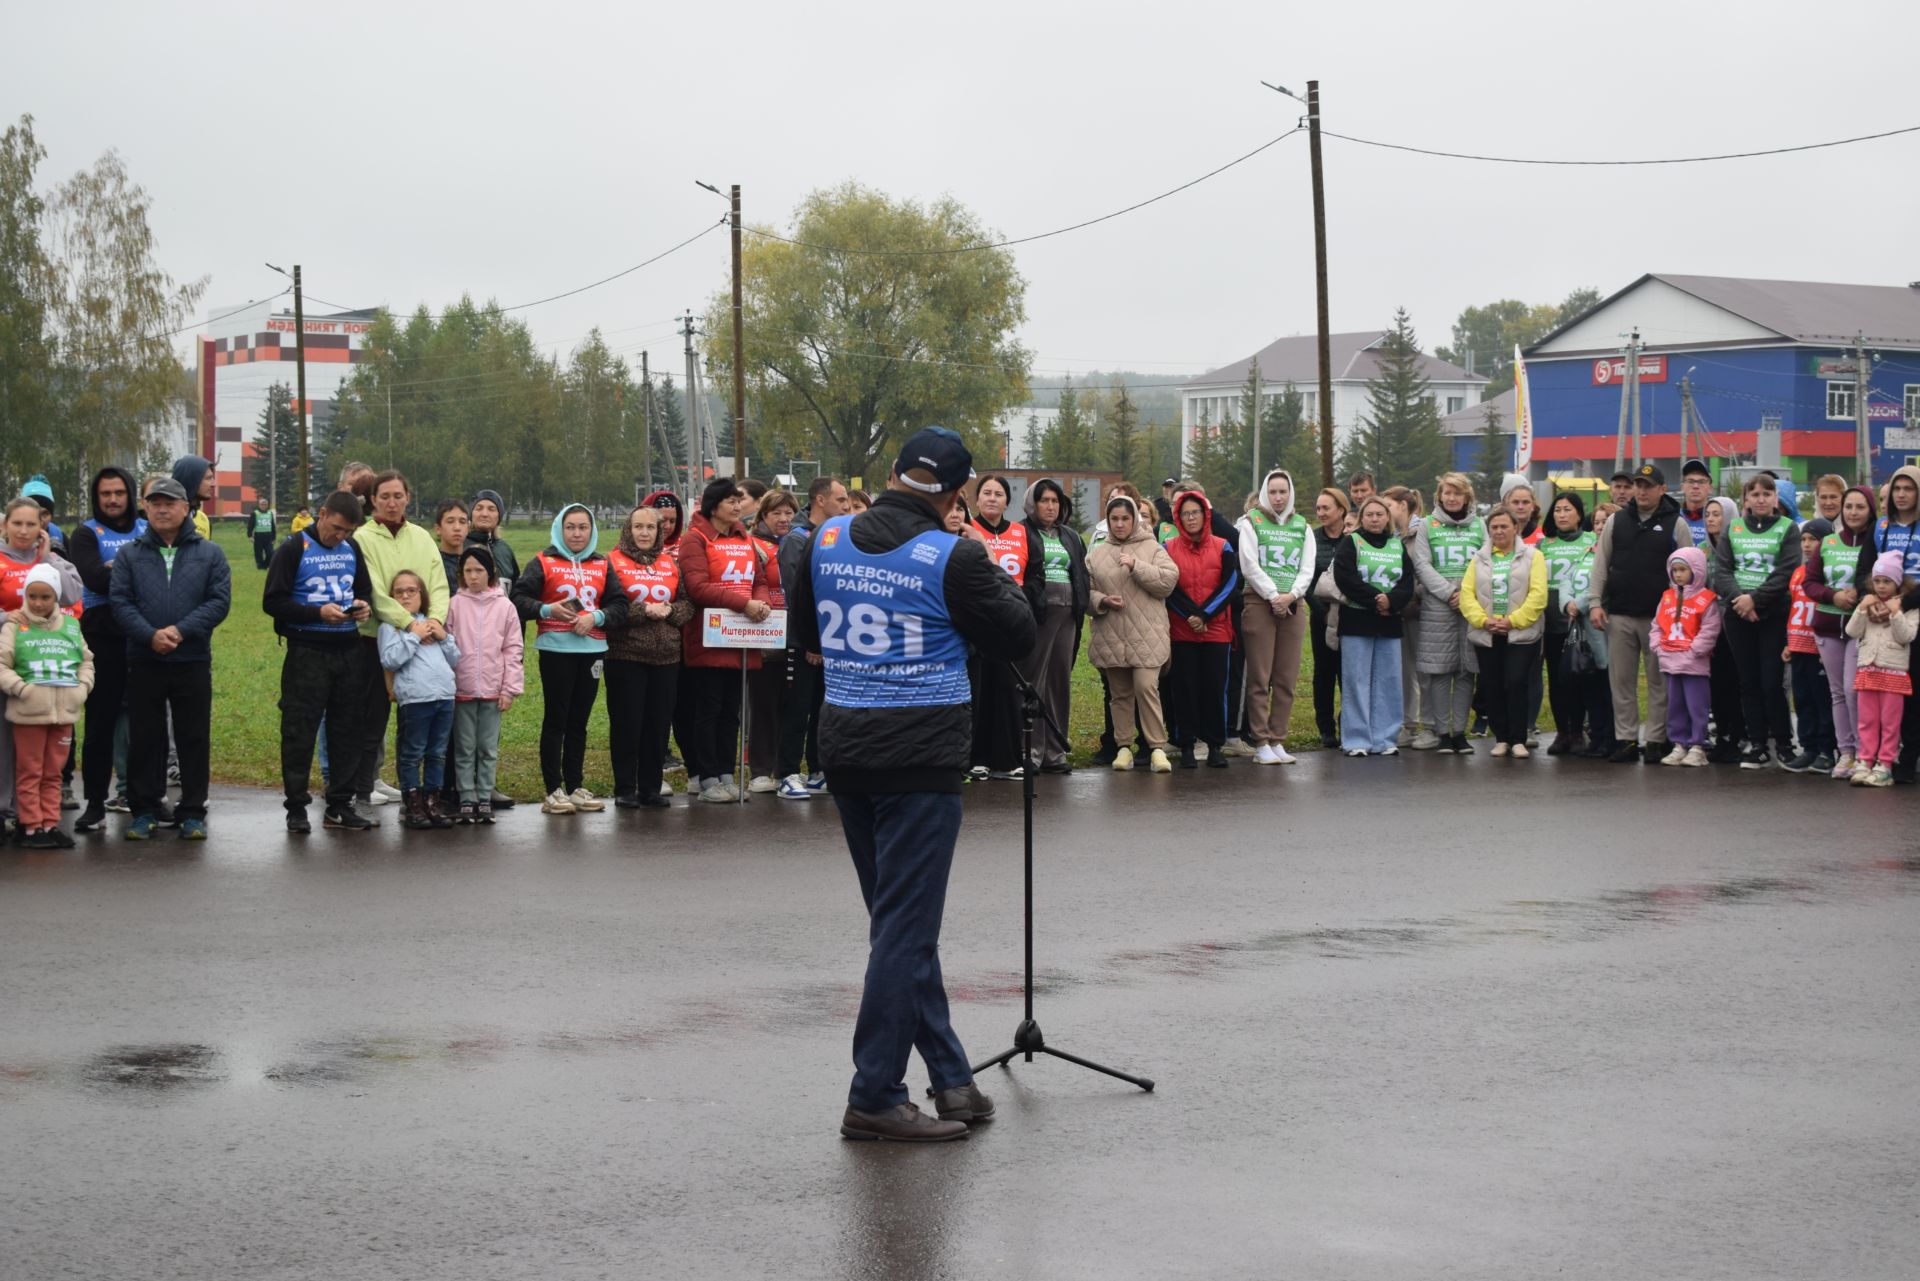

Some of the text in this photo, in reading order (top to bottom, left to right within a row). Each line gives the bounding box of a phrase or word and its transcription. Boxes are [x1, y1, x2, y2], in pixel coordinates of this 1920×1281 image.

[267, 321, 369, 333] МӘДНИЯТ ЙОР
[726, 549, 748, 557] РАЙОН
[986, 539, 1021, 547] АЕВСКИЙ
[304, 553, 354, 565] ТУКАЕВСКИЙ
[318, 562, 346, 571] РАЙОН
[1258, 545, 1300, 569] 134
[1734, 552, 1776, 573] 121
[551, 567, 603, 578] ТУКАСКИЙ
[623, 569, 672, 578] ТУКАЕСКИЙ
[721, 560, 755, 584] 44
[819, 563, 924, 592] ТУКАЕВСКИЙ
[1358, 565, 1403, 588] 142
[1546, 558, 1577, 581] 12
[1574, 569, 1591, 590] 5
[305, 574, 354, 602] 212
[556, 585, 598, 612] 28
[627, 583, 671, 603] 29
[836, 577, 894, 599] РАЙОН
[1791, 600, 1815, 626] 21
[721, 626, 784, 638] Иштеряковское
[817, 599, 924, 659] 281
[39, 645, 69, 656] РАЙОН
[28, 659, 78, 681] 115
